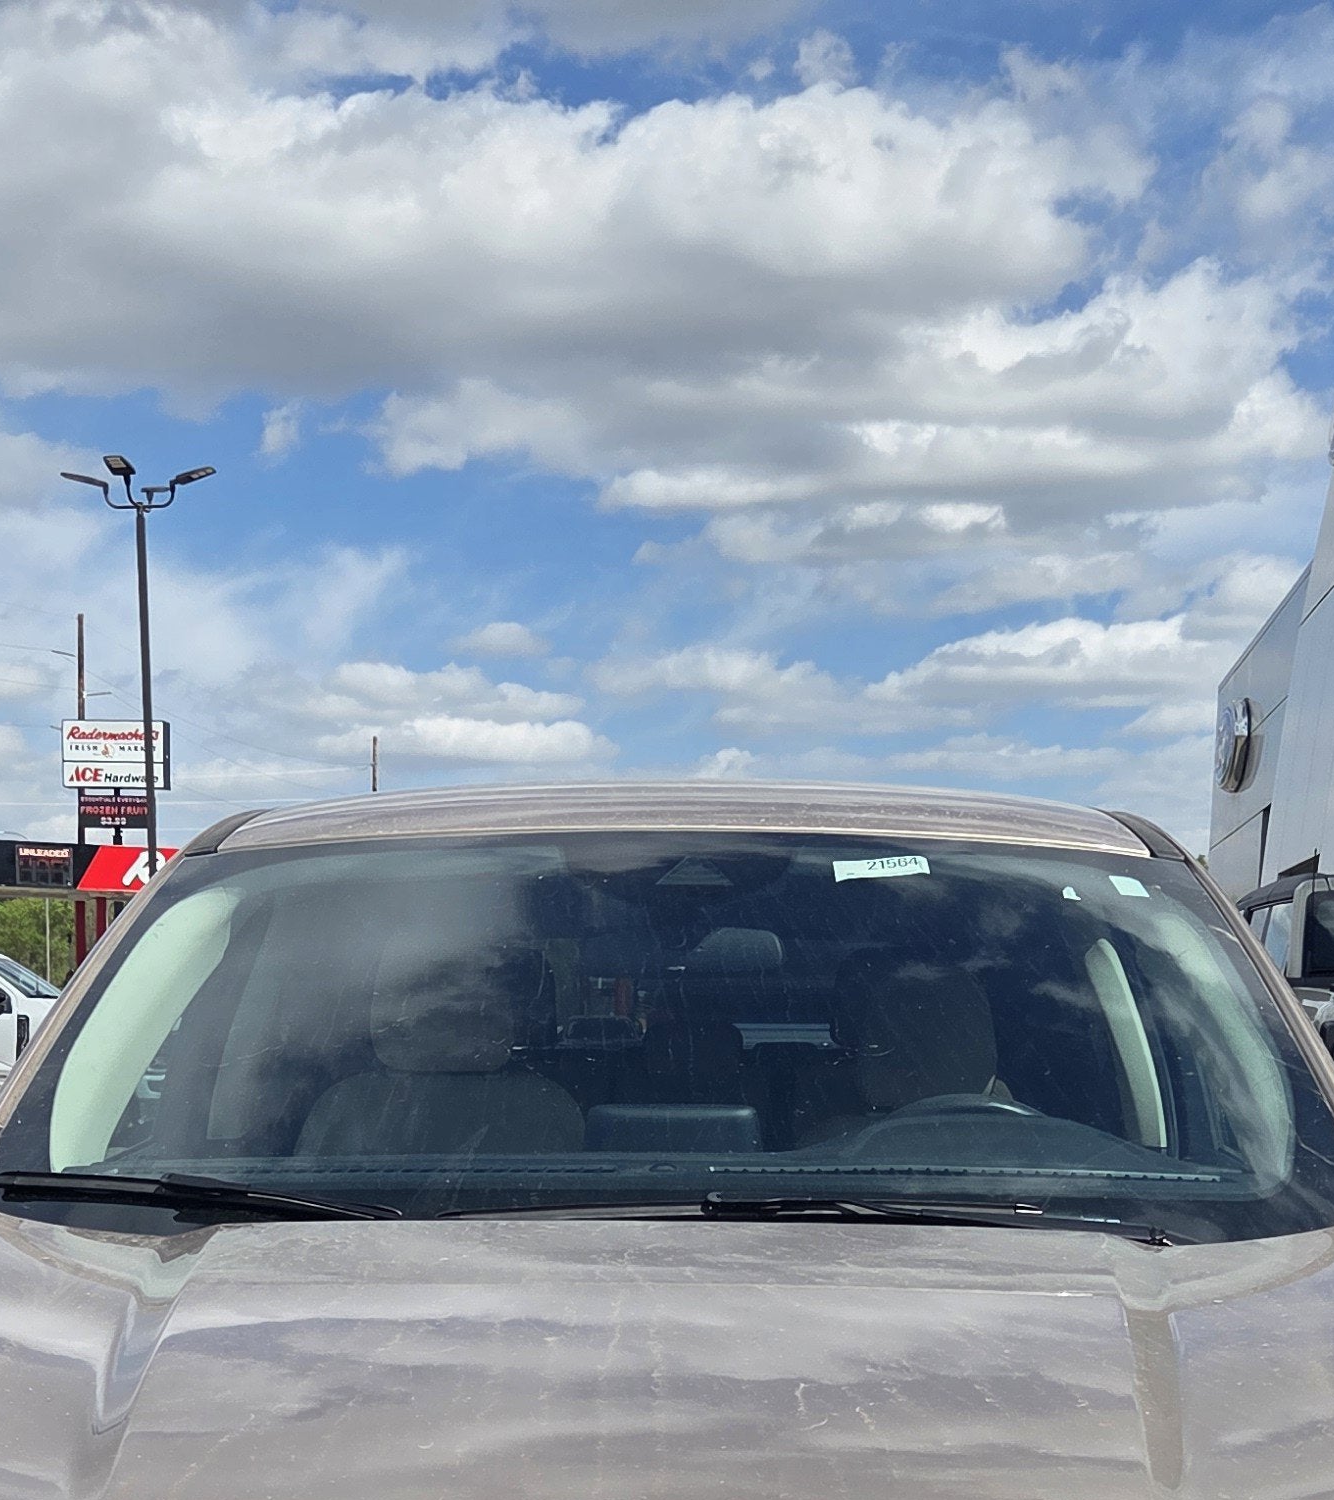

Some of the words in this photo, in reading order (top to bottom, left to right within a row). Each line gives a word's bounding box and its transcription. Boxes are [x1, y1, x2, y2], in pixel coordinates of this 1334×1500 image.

[69, 766, 104, 782] ACE
[104, 773, 159, 783] Hardwae
[80, 805, 118, 815] FROZEN
[866, 857, 919, 870] 21564
